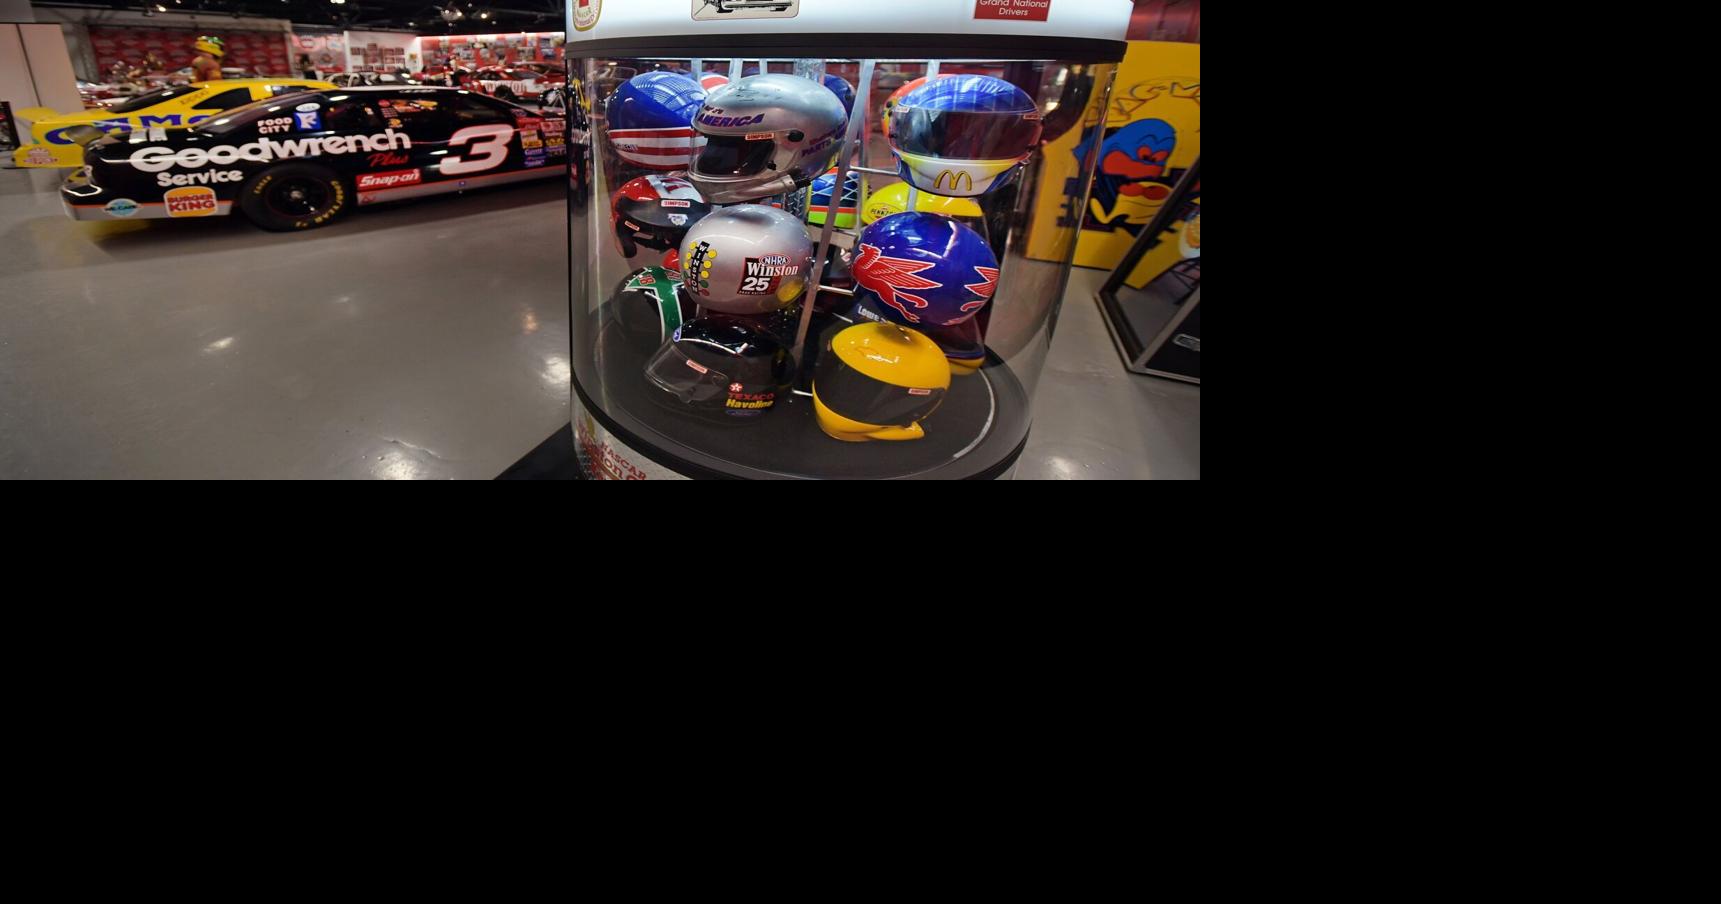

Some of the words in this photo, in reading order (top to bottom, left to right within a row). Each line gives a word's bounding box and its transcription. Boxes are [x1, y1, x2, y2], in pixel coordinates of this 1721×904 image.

[1013, 0, 1048, 8] National
[999, 8, 1028, 16] Drivers
[257, 117, 293, 128] FOOD
[258, 125, 291, 135] CITY
[129, 127, 413, 173] Goodwrench
[440, 123, 515, 175] 3
[367, 152, 409, 168] Plus
[157, 166, 245, 187] Service
[167, 194, 214, 203] BURGER
[168, 200, 216, 212] KING
[764, 255, 788, 265] NHRA
[691, 244, 708, 292] WINSTON
[746, 261, 799, 277] Winston
[741, 276, 771, 292] 25
[725, 398, 774, 409] Havoline
